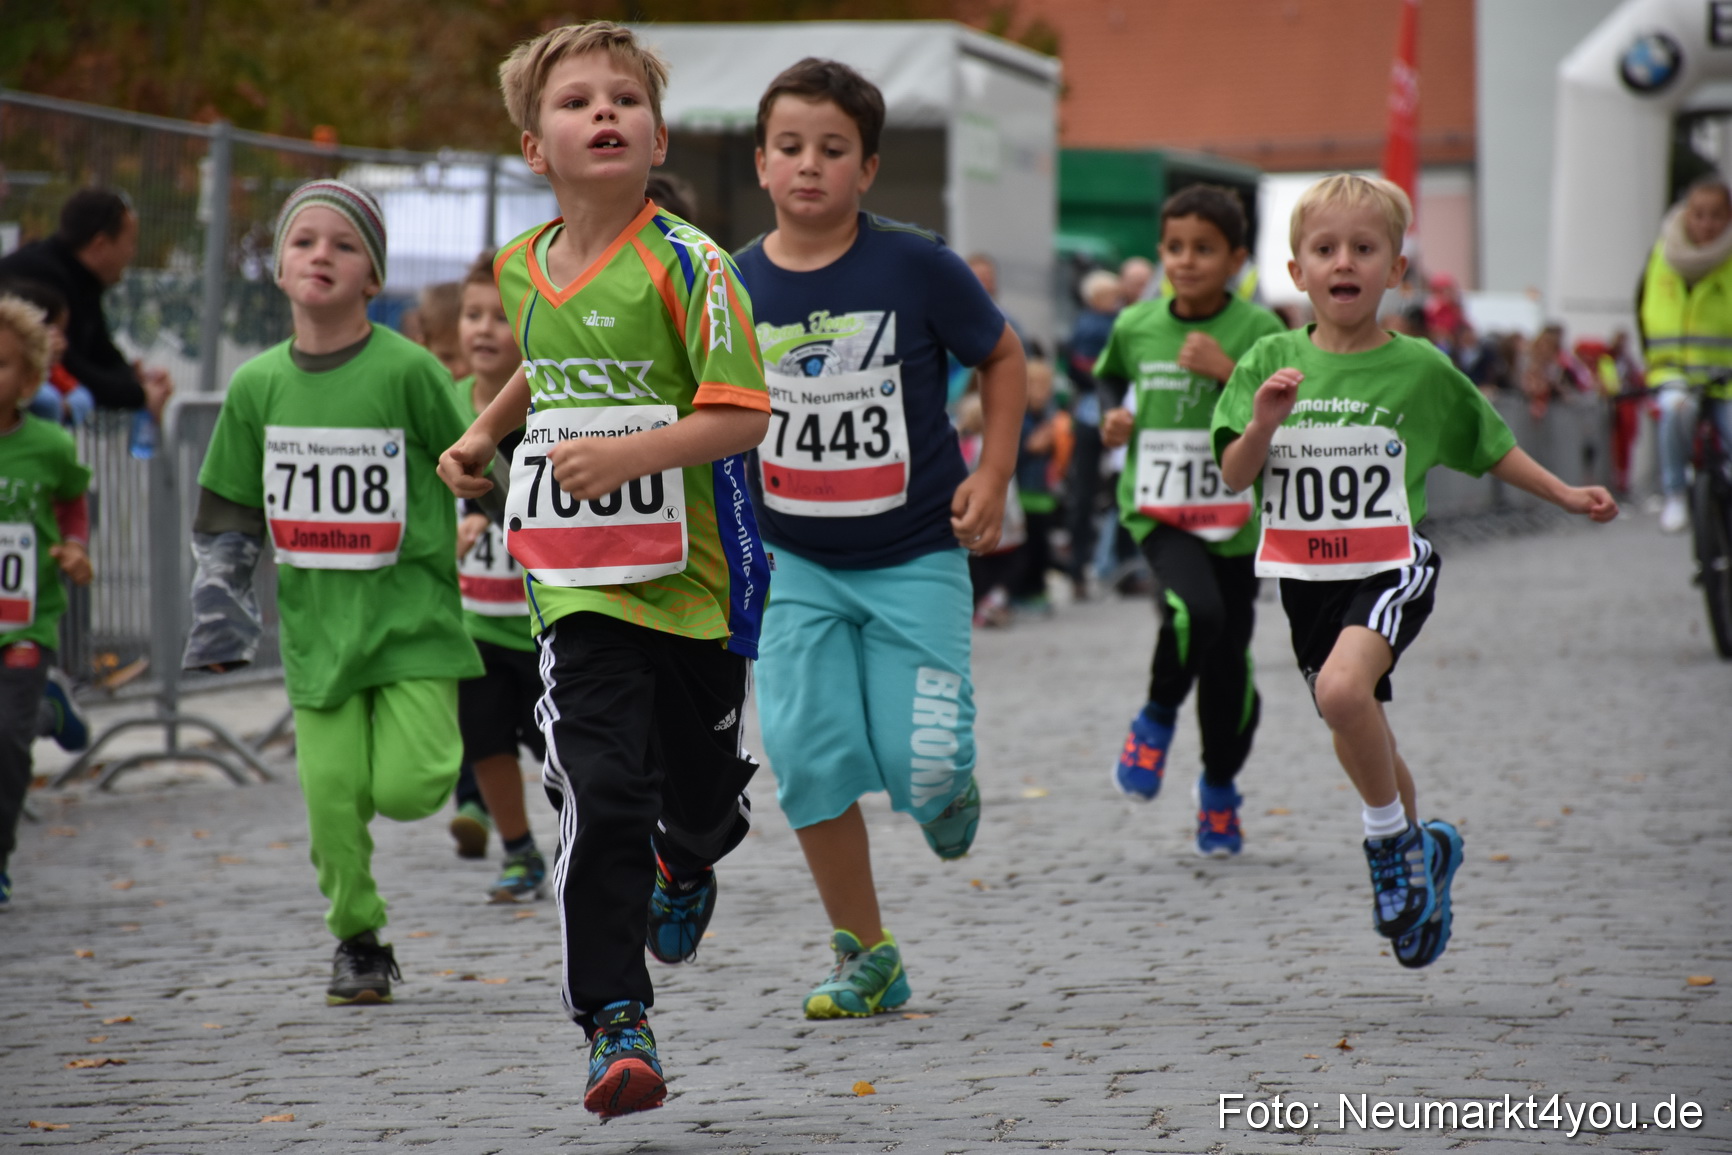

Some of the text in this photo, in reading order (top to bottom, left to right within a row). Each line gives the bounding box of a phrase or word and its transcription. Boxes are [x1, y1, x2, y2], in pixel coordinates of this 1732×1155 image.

[802, 386, 875, 405] Neumarkt
[770, 405, 891, 462] 7443
[308, 443, 377, 457] Neumarkt
[1301, 443, 1379, 458] Neumarkt
[275, 463, 390, 515] 7108
[1153, 460, 1237, 499] 715
[1271, 464, 1392, 523] 7092
[290, 528, 371, 549] Jonathan
[1308, 537, 1348, 559] Phil
